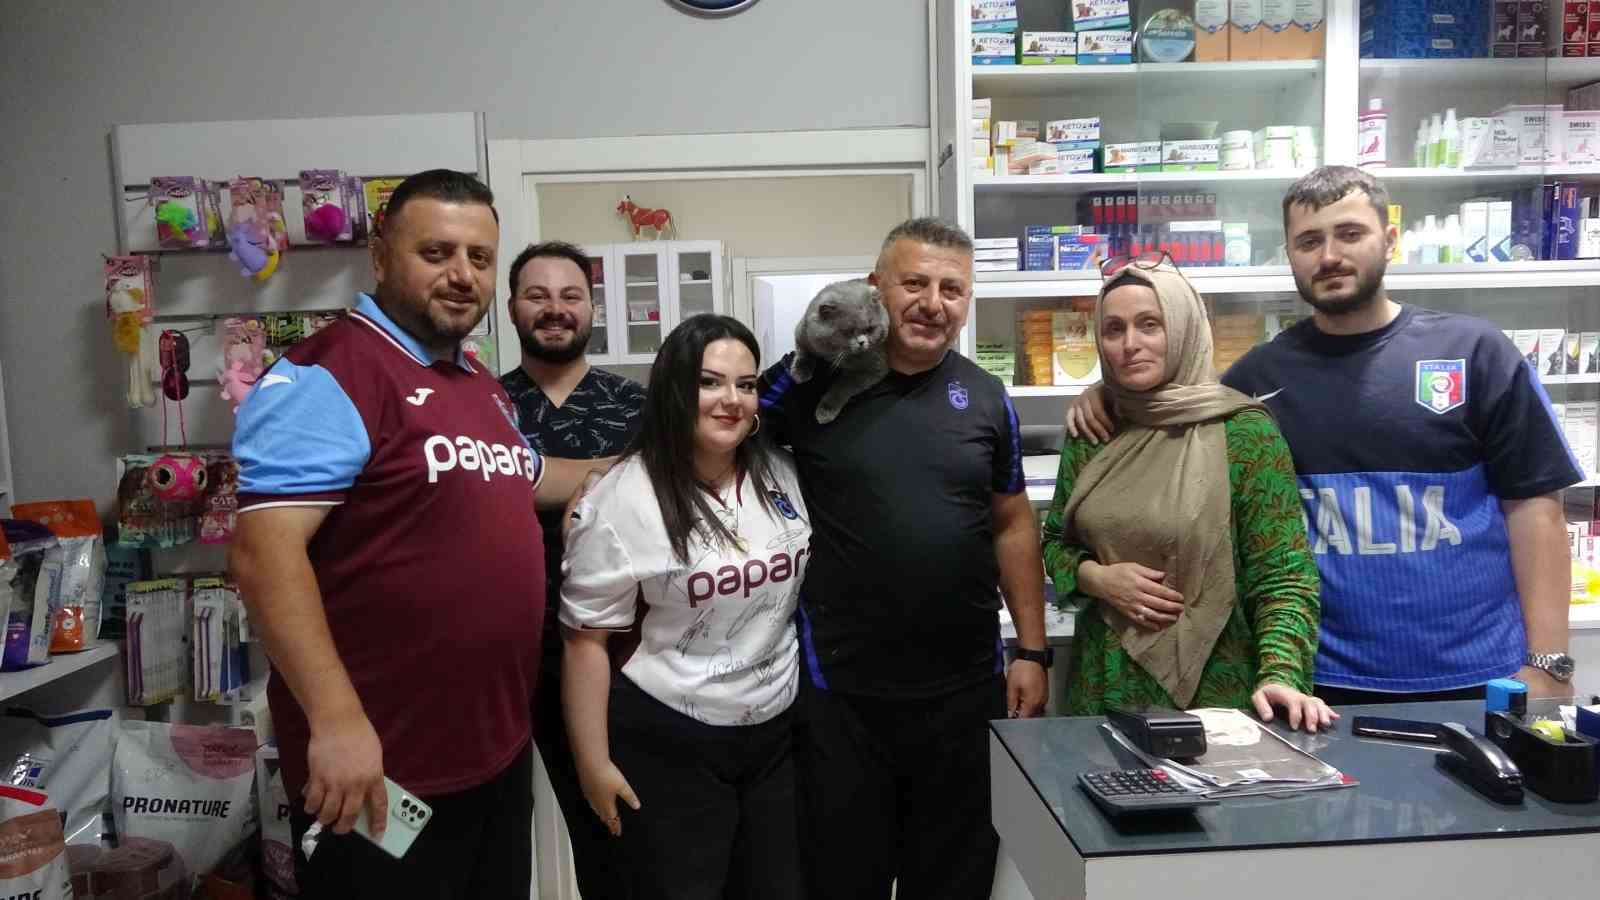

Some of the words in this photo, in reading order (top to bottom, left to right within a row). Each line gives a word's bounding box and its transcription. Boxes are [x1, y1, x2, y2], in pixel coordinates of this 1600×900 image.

[424, 435, 535, 482] papara
[1299, 484, 1462, 555] TALIA
[687, 546, 812, 608] papar
[123, 796, 231, 818] PRONATURE
